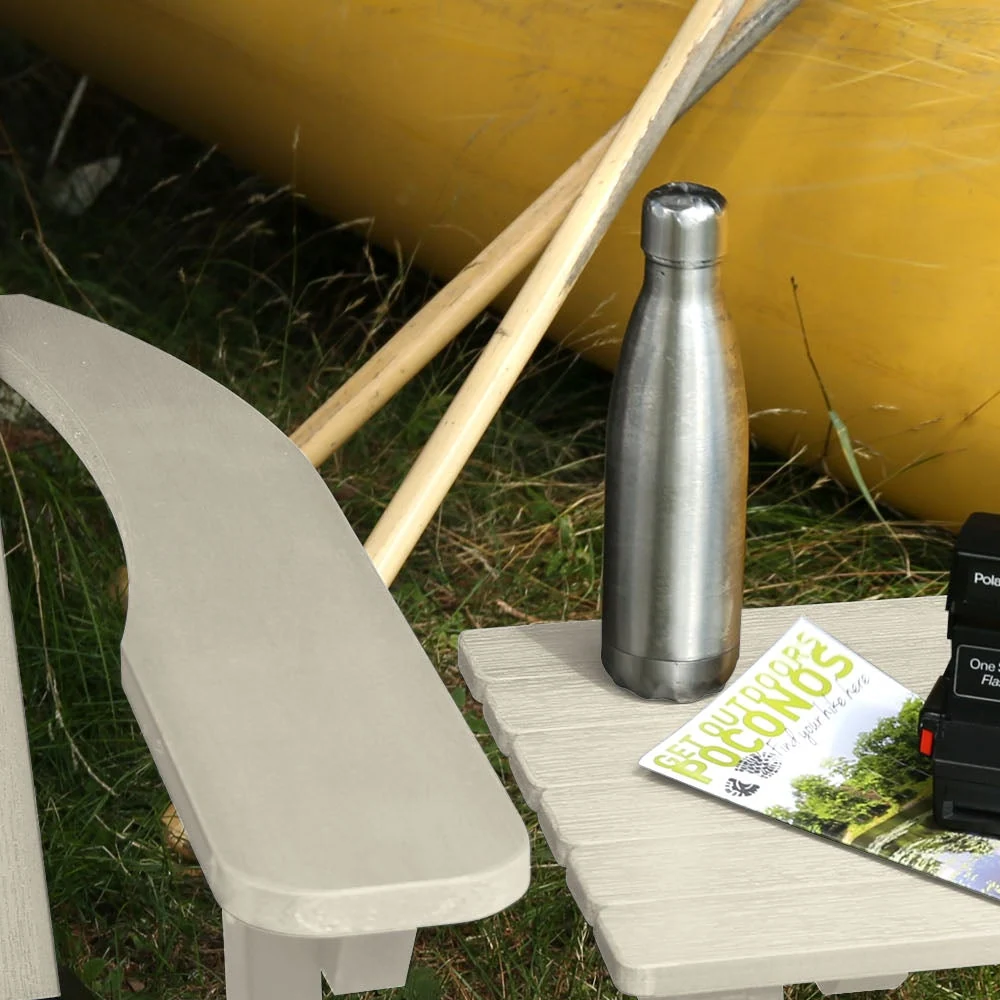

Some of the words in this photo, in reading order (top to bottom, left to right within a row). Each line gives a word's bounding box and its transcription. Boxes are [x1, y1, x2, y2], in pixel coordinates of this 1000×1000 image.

[653, 734, 702, 769] GET
[698, 631, 820, 737] OUTDOORS
[970, 658, 995, 672] One
[671, 639, 854, 785] POCONOS
[798, 716, 822, 746] your
